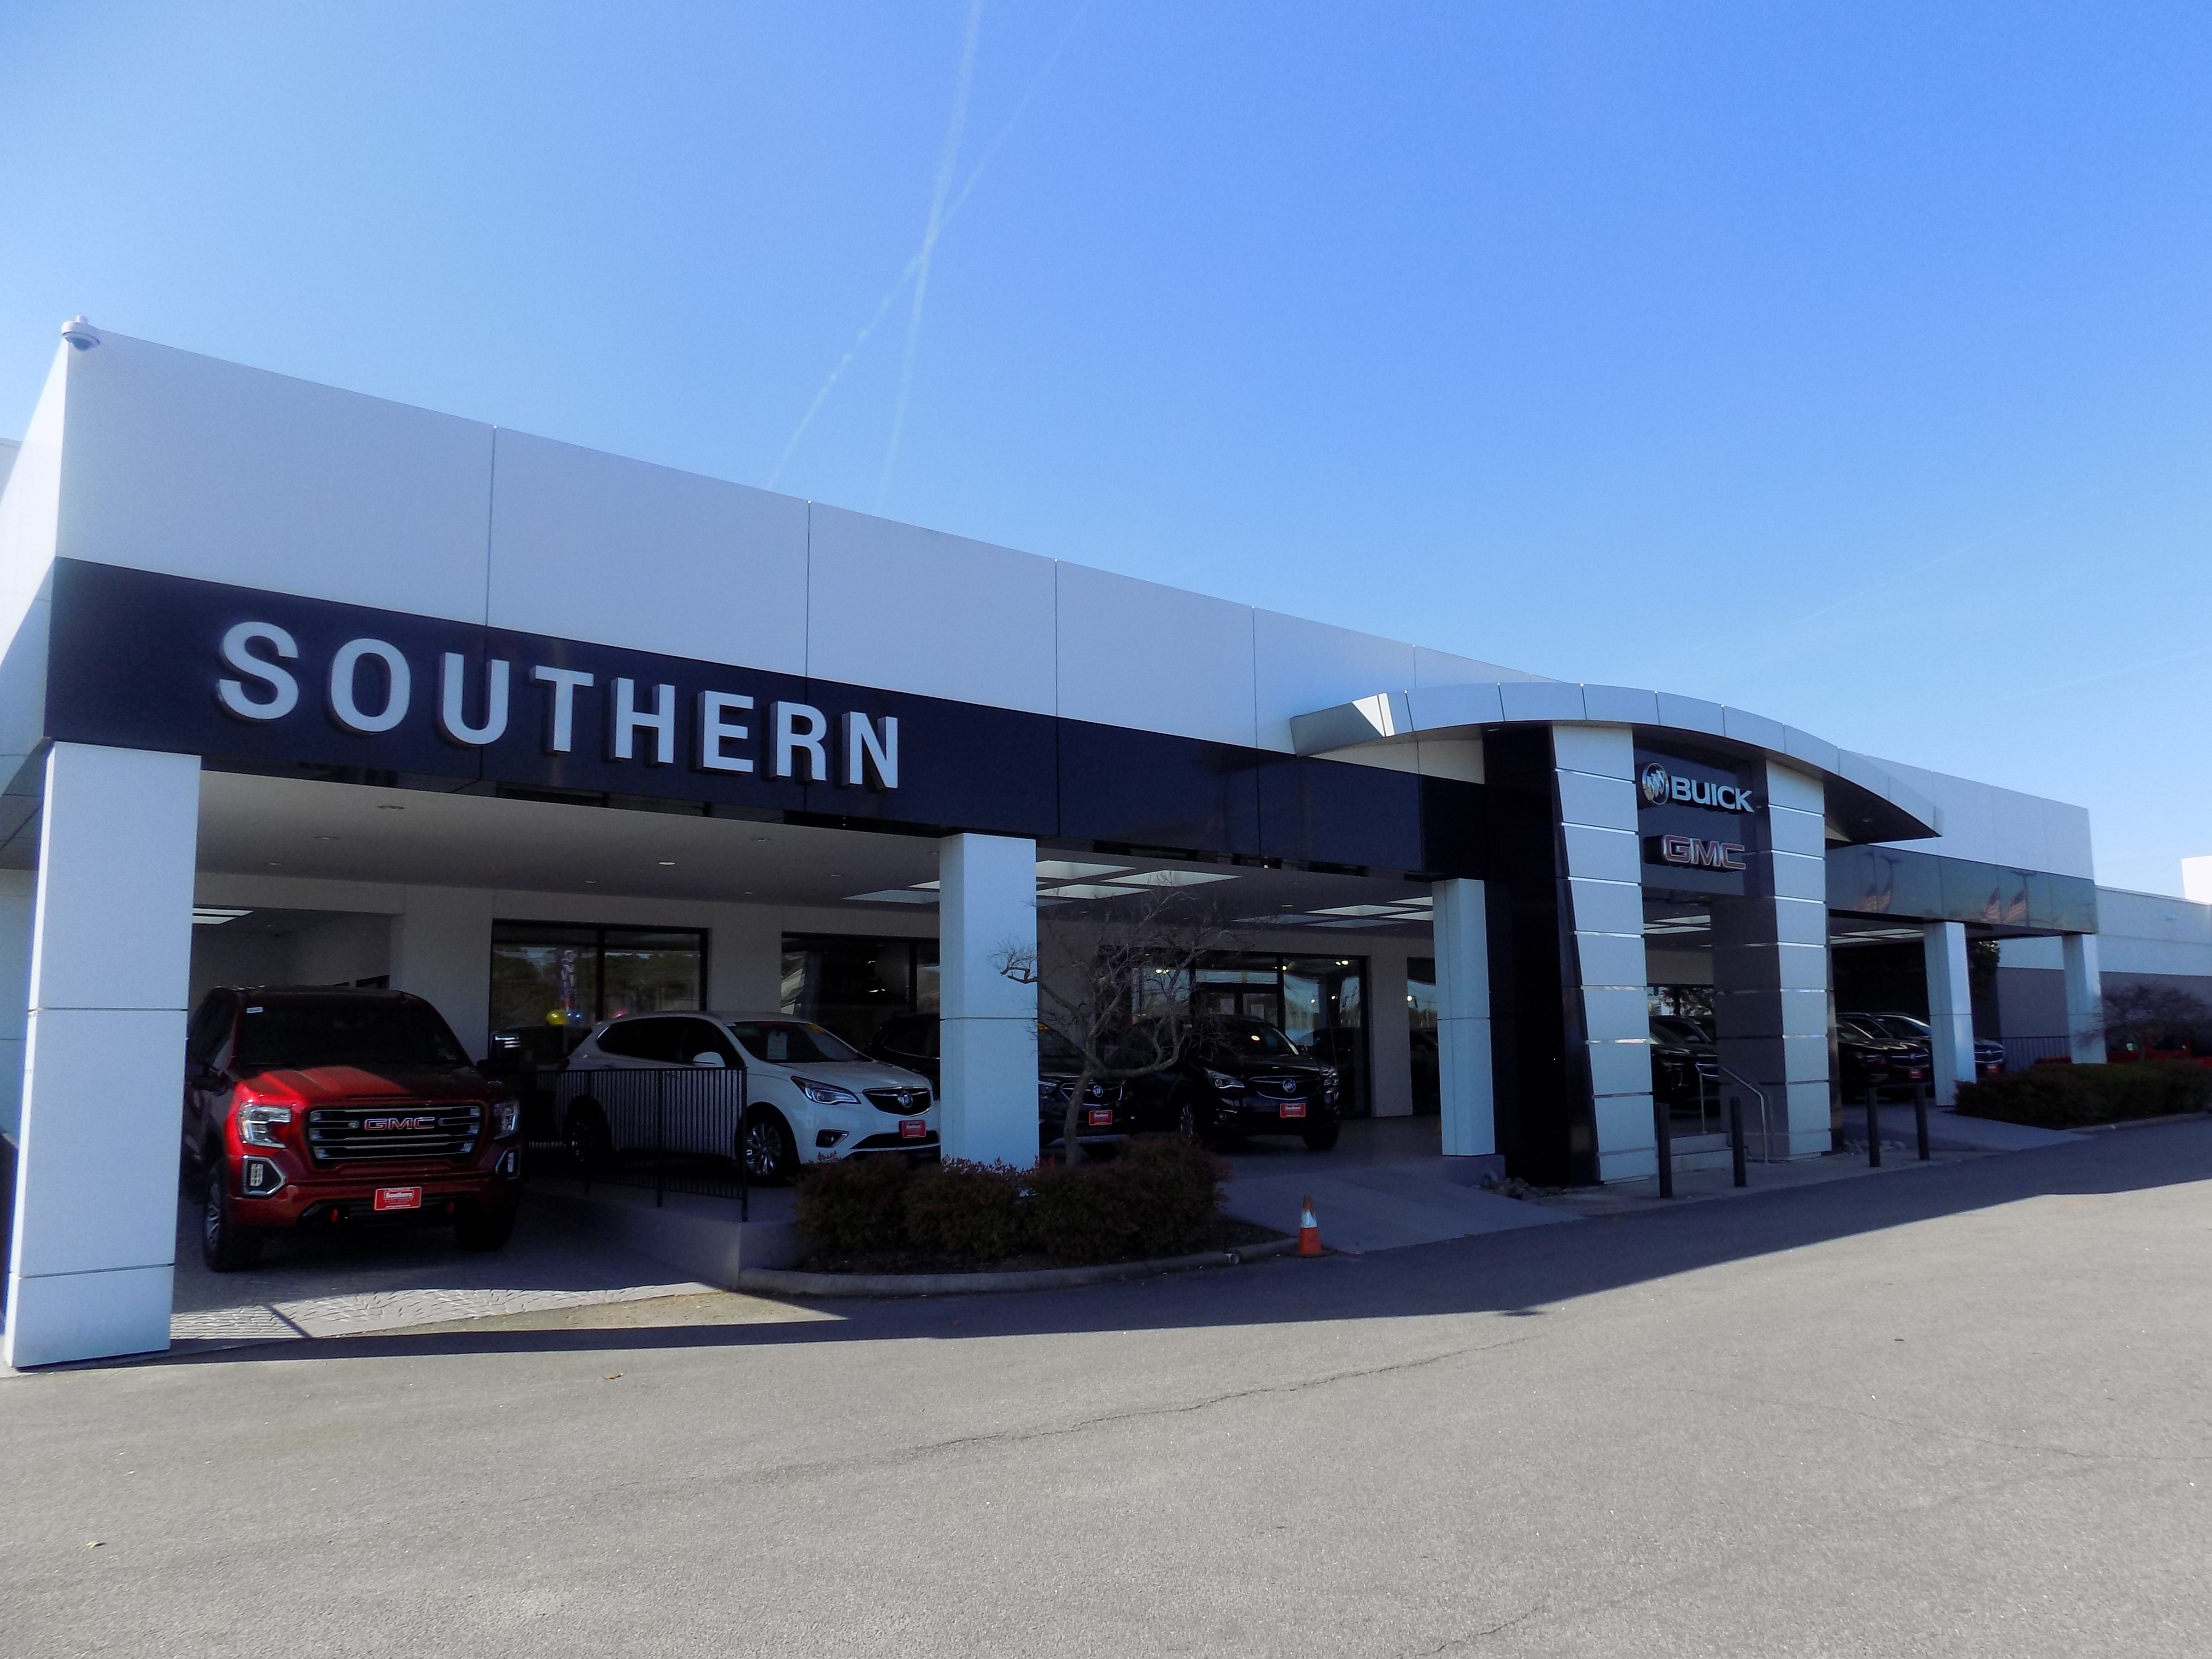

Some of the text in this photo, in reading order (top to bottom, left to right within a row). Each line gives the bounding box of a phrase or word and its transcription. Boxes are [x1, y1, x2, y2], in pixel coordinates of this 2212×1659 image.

[218, 621, 899, 789] SOUTHERN
[1671, 776, 1754, 812] BUICK
[1663, 834, 1746, 870] GMC
[364, 1117, 435, 1130] GMC
